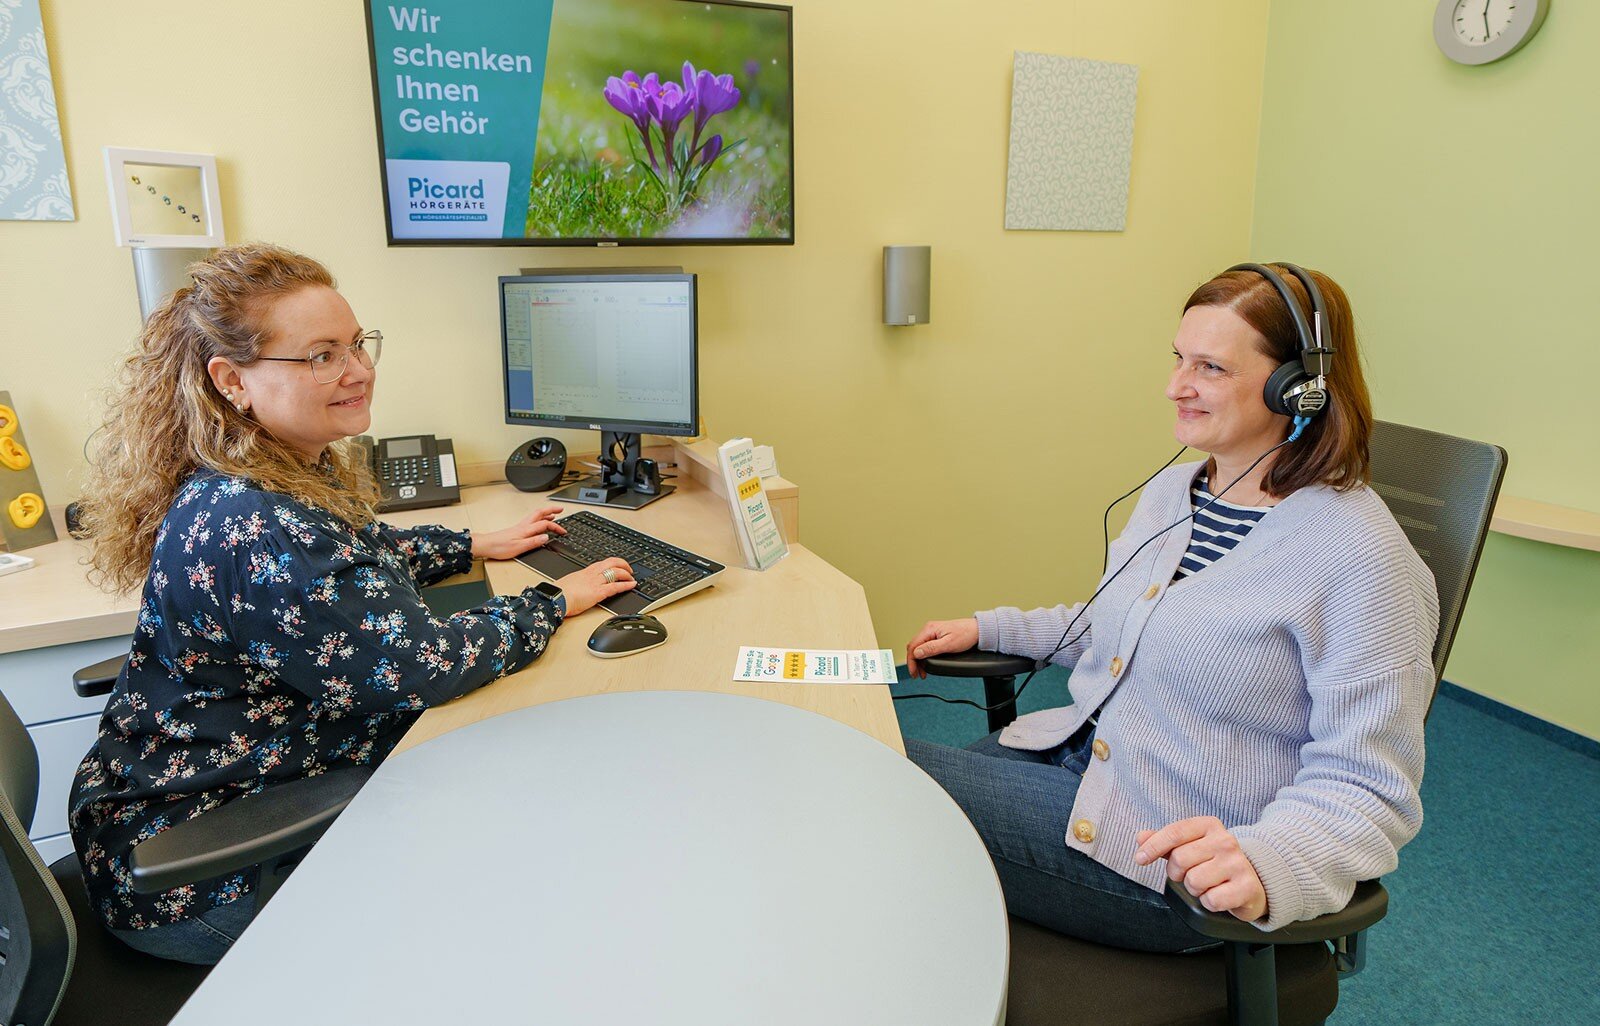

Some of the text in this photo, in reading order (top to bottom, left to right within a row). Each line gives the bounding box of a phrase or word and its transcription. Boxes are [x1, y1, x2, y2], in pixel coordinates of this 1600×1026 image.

[388, 5, 441, 34] Wir
[393, 43, 532, 73] schenken
[396, 74, 479, 103] Ihnen
[399, 108, 489, 135] Gehör
[408, 177, 484, 199] Picard
[410, 200, 486, 210] HÖRGERÄTE
[736, 465, 754, 479] Google
[763, 654, 781, 675] Google
[814, 656, 826, 676] Picard
